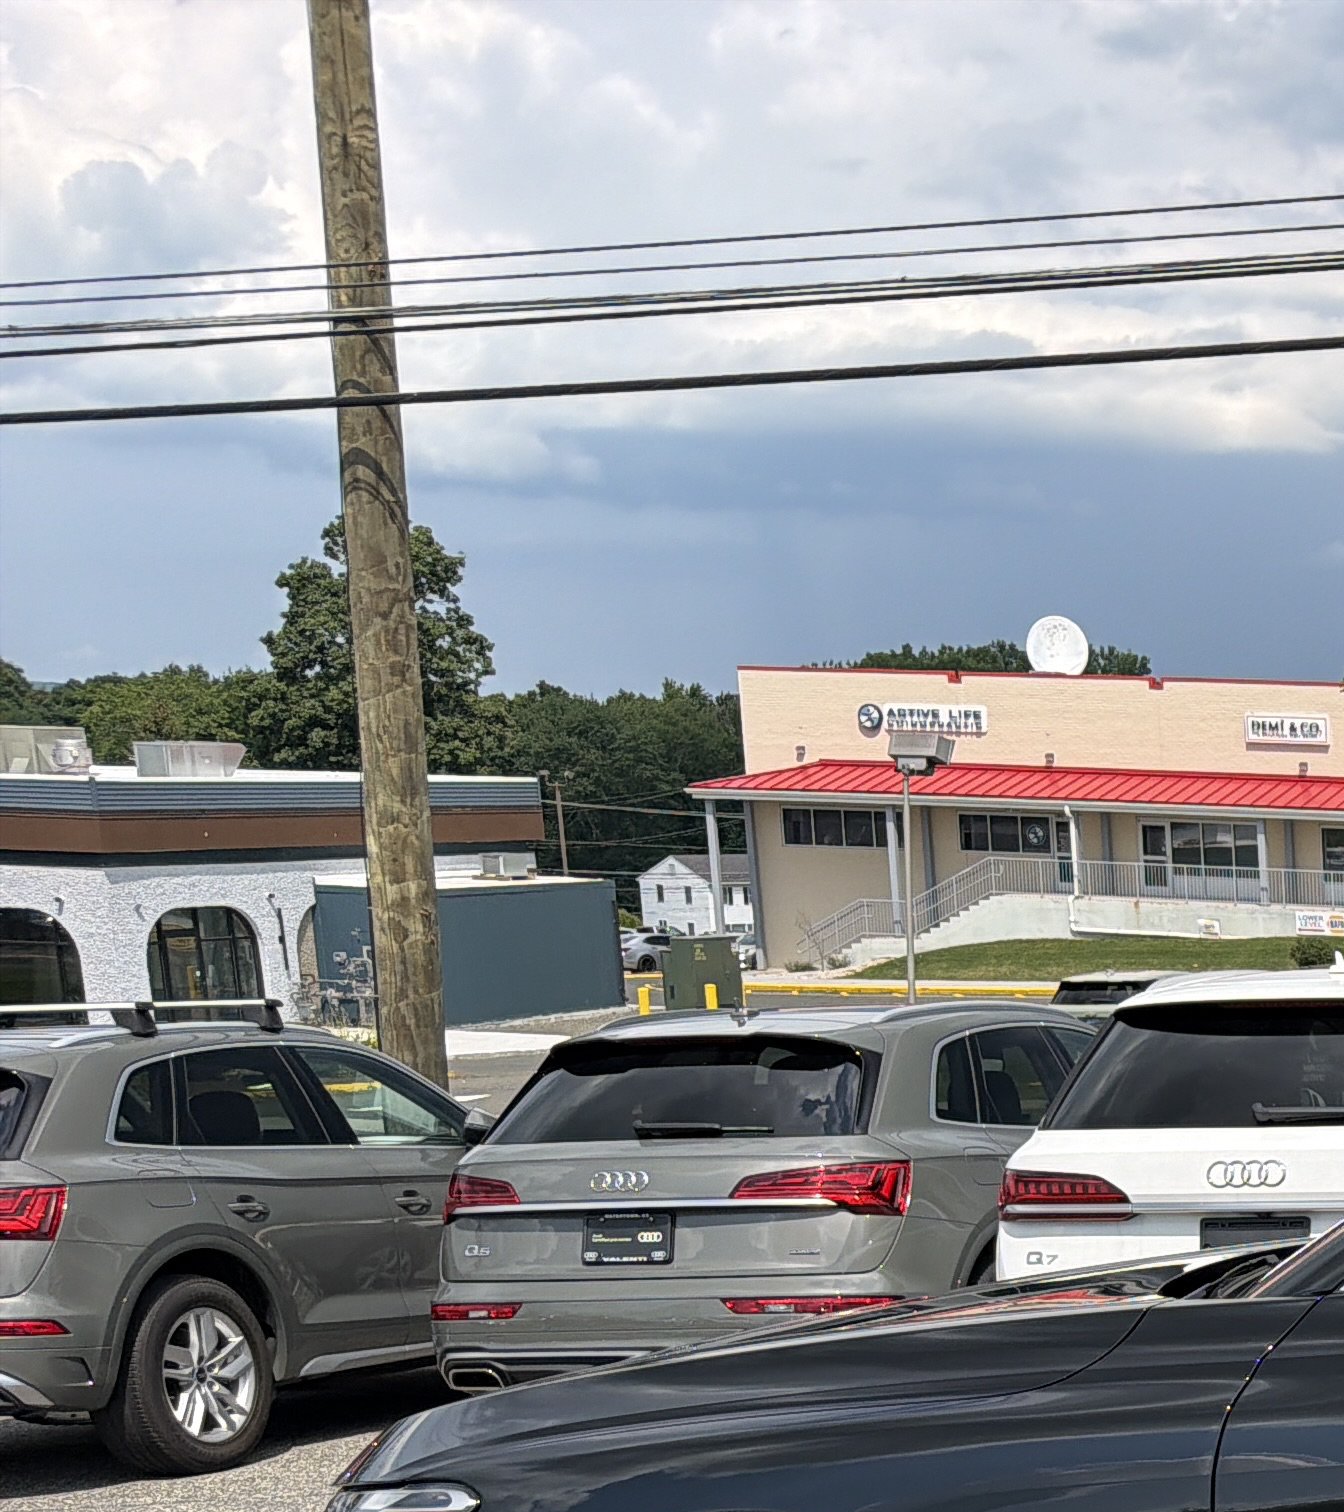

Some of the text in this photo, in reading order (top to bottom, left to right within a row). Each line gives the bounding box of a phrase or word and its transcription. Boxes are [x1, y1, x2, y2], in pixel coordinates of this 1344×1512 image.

[947, 709, 982, 721] LIFE
[1298, 914, 1324, 922] LOWER
[464, 1244, 490, 1257] Q5
[1026, 1250, 1059, 1265] Q7
